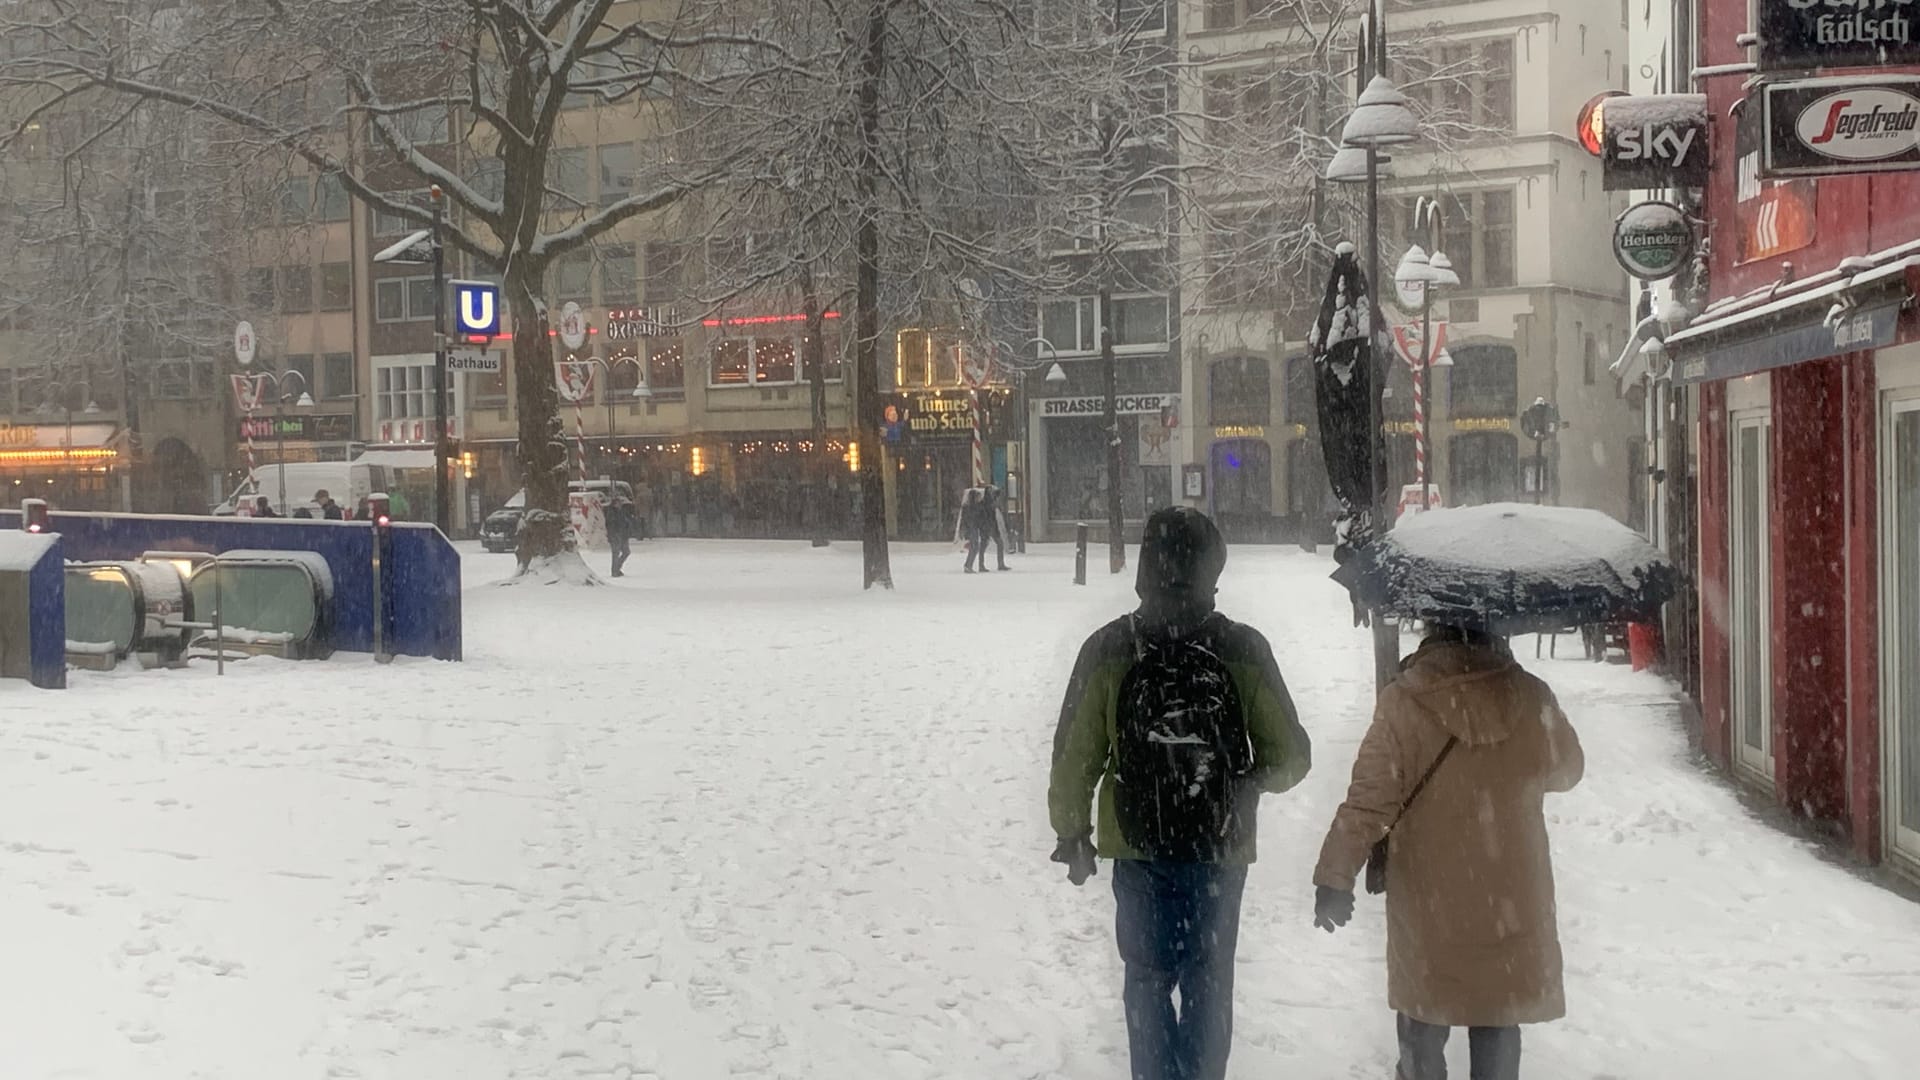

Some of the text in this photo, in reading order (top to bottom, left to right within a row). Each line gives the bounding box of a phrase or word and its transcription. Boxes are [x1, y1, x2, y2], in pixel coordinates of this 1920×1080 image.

[1811, 100, 1918, 144] Segafredo
[1616, 122, 1696, 167] sky
[1623, 234, 1687, 248] Heineken
[461, 291, 493, 329] U
[448, 356, 498, 369] Rathaus
[911, 415, 938, 430] und
